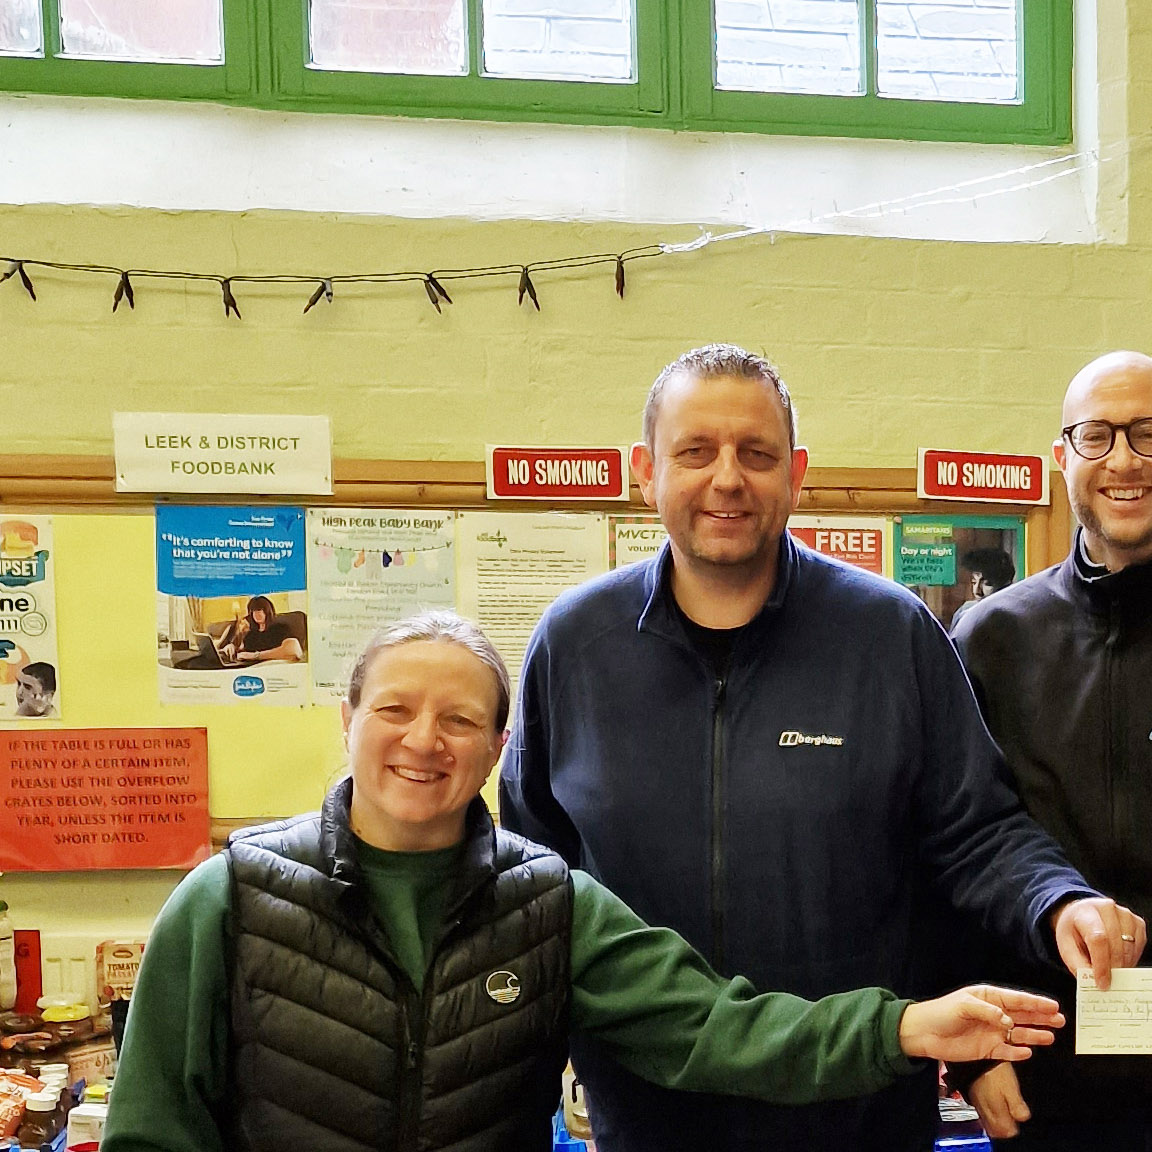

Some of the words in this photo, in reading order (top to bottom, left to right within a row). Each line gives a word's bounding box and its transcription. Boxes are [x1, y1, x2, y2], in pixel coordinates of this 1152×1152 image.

[144, 435, 193, 449] LEEK
[199, 436, 210, 449] &
[217, 436, 300, 450] DISTRICT
[171, 461, 276, 475] FOODBANK
[507, 459, 530, 485] NO
[534, 459, 609, 486] SMOKING
[937, 461, 958, 486] NO
[962, 462, 1031, 490] SMOKING
[617, 529, 660, 540] MVCT
[190, 536, 250, 549] comforting
[251, 538, 263, 548] to
[264, 537, 293, 549] know
[815, 531, 877, 553] FREE
[172, 548, 195, 558] that
[231, 550, 250, 560] not
[900, 546, 918, 556] Day
[930, 547, 953, 557] night
[23, 740, 47, 751] THE
[51, 740, 90, 751] TABLE
[94, 740, 105, 750] IS
[109, 739, 139, 750] FULL
[143, 739, 161, 749] OR
[165, 738, 191, 749] HAS
[798, 733, 844, 746] berghaus
[11, 758, 57, 769] PLENTY
[61, 758, 79, 769] OF
[82, 759, 91, 768] A
[95, 758, 150, 769] CERTAIN
[11, 777, 57, 788] PLEASE
[61, 777, 83, 788] USE
[88, 776, 111, 787] THE
[117, 776, 190, 787] OVERFLOW
[5, 796, 53, 808] CRATES
[111, 795, 162, 806] SORTED
[165, 793, 197, 805] INTO
[58, 814, 106, 825] UNLESS
[110, 813, 134, 825] THE
[139, 813, 170, 823] ITEM
[174, 812, 186, 822] IS
[54, 833, 97, 844] SHORT
[101, 832, 149, 843] DATED.
[107, 962, 140, 971] TOMATO
